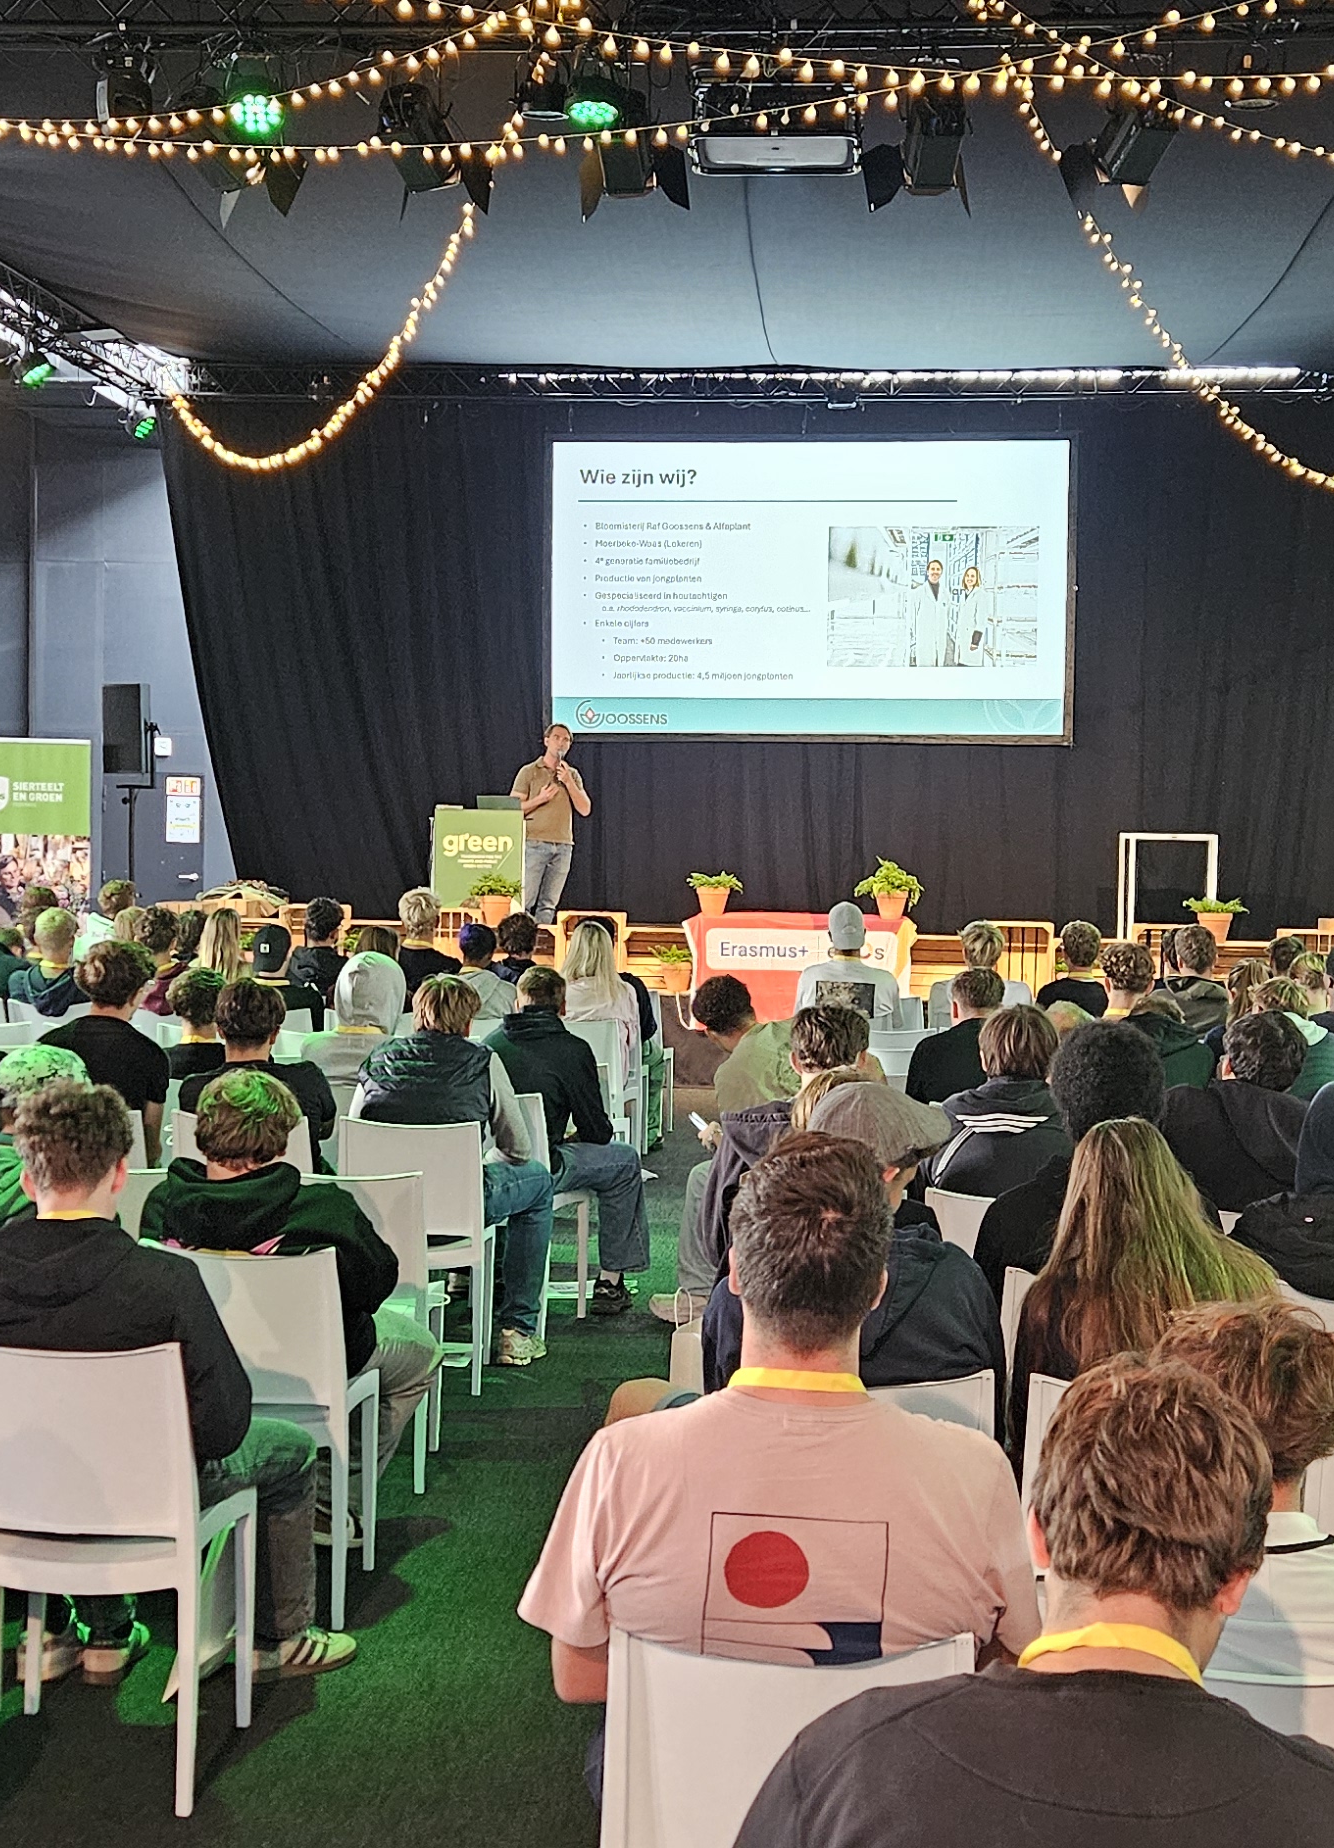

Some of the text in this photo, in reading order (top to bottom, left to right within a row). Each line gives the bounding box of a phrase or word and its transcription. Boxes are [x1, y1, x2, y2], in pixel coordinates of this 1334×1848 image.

[579, 469, 697, 488] Wie zijn wij?
[646, 522, 661, 530] Raf
[661, 522, 704, 530] Goossens
[705, 522, 711, 530] &
[713, 522, 751, 532] Alfaplant
[663, 539, 703, 549] (Lokeren)
[605, 557, 644, 566] generatie
[645, 557, 700, 566] familiebedrijf
[595, 574, 635, 582] Productie
[652, 574, 702, 584] jongplanten
[595, 592, 662, 600] Gespecialiseerd
[672, 592, 728, 601] houtachtigen
[595, 619, 649, 629] Enkele cijfers
[613, 636, 638, 645] Team:
[657, 636, 713, 645] medewerkers
[613, 654, 689, 663] Oppervlakte: 20ha
[652, 671, 696, 681] productie:
[743, 671, 794, 681] jongplanten
[12, 781, 65, 792] SIERTEELT
[12, 792, 63, 803] EN GROEN
[442, 832, 514, 858] green
[720, 941, 809, 959] Erasmus+
